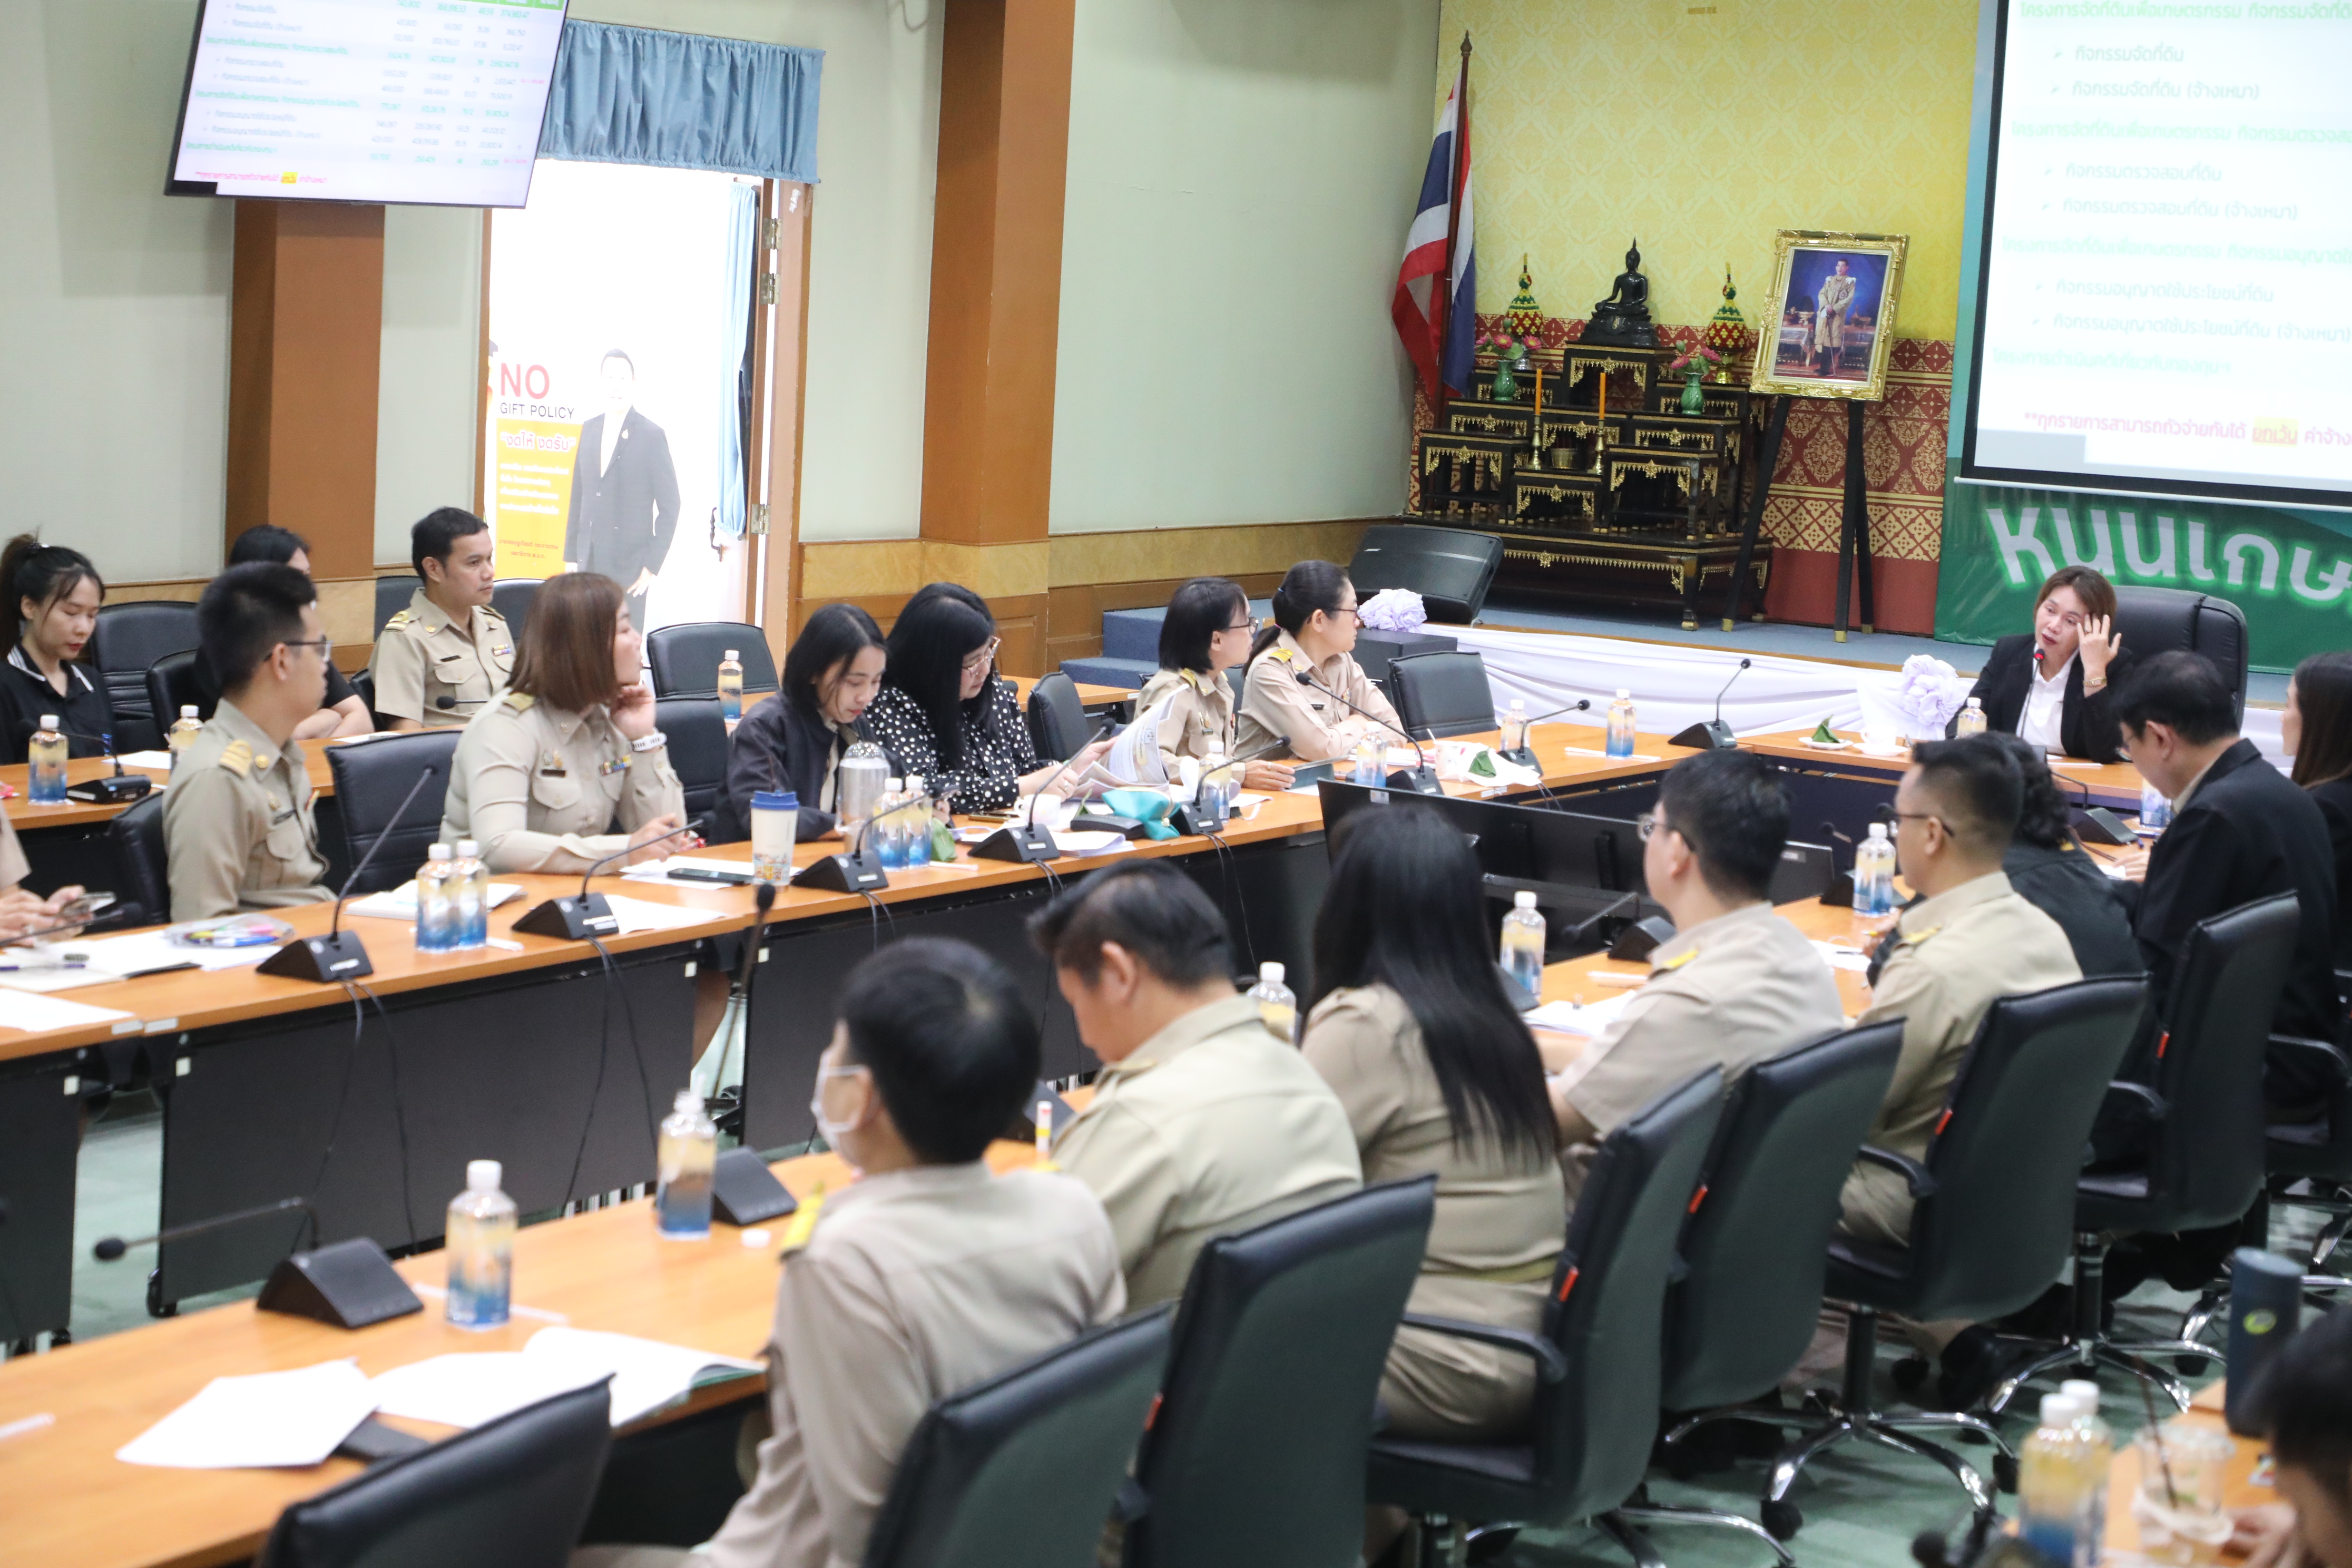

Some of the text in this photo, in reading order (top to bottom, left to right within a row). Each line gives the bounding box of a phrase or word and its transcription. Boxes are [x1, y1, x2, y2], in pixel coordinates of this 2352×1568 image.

[2075, 42, 2184, 62] กิจกรรมจัดที่ดิน
[2072, 77, 2260, 100] กิจกรรมจัดที่ดิน (จ้างเหมา)
[2011, 119, 2231, 141] โครงการจัดที่ดินเพื่อเกษตรกรรม
[2066, 161, 2222, 182] กิจกรรมตรวจสอบที่ดิน
[2063, 195, 2299, 221] กิจกรรมตรวจสอบที่ดิน (จ้างเหมา)
[2056, 279, 2273, 303] กิจกรรมอนุญาตใช้ประโยชน์ที่ดิน
[2053, 313, 2351, 343] กิจกรรมอนุญาตใช้ประโยชน์ที่ดิน (จ้างเหมา)
[501, 363, 550, 399] NO
[500, 403, 574, 419] GIFT POLICY
[2252, 422, 2298, 445] ยกเว้น
